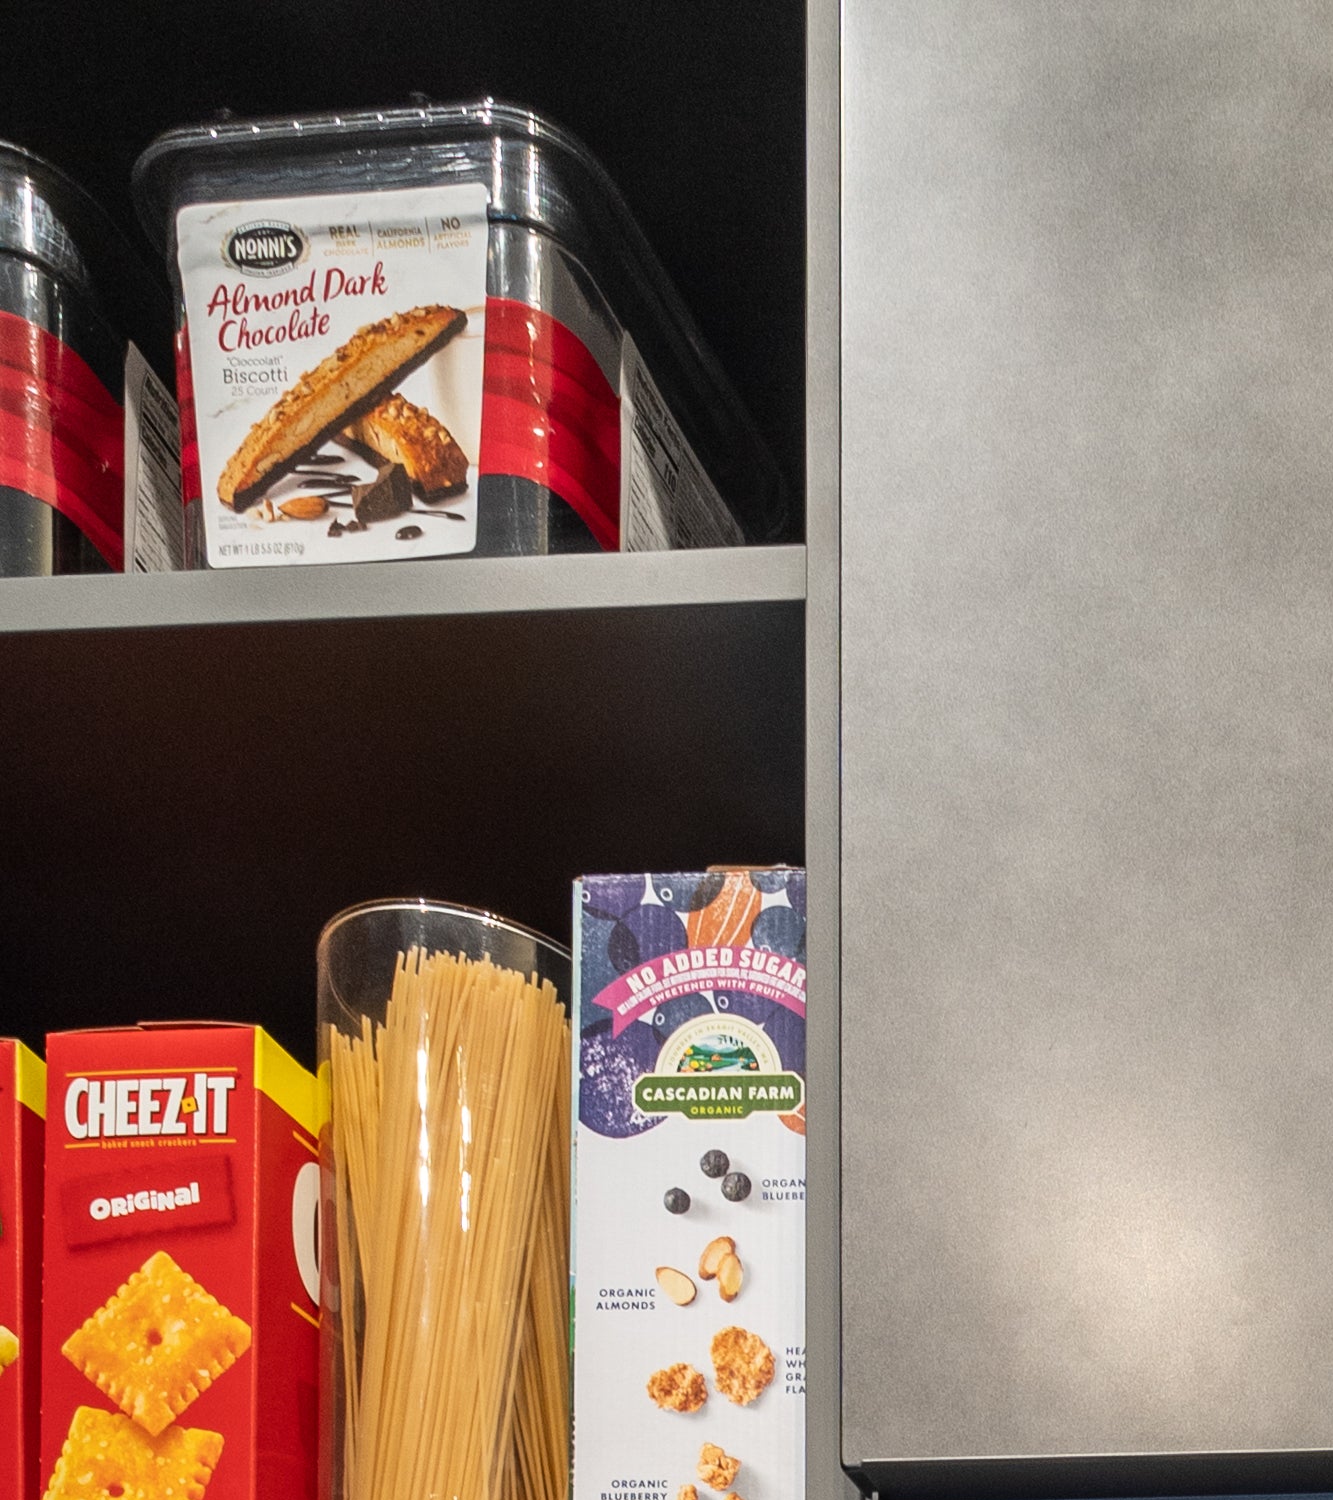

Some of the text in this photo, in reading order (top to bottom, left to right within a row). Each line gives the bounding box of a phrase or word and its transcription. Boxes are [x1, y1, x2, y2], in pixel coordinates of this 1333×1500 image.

[441, 218, 461, 230] NO
[329, 226, 360, 239] REAL
[234, 235, 297, 260] NONNI'S
[377, 239, 425, 249] ALMONDS
[207, 261, 388, 317] Almond Dark
[218, 306, 330, 351] Chocolate
[223, 368, 288, 384] Biscotti
[626, 949, 806, 993] NO ADDED SUGAR
[649, 978, 745, 1005] SWEETENED WITH
[642, 1087, 794, 1101] CASCADIAN FARM
[691, 1106, 743, 1115] ORGANIC
[102, 1138, 197, 1149] baked snack crackers
[600, 1289, 656, 1297] ORGANIC
[597, 1302, 656, 1310] ALMONDS
[612, 1480, 668, 1488] ORGANIC
[601, 1493, 667, 1500] BLUEBERRY
